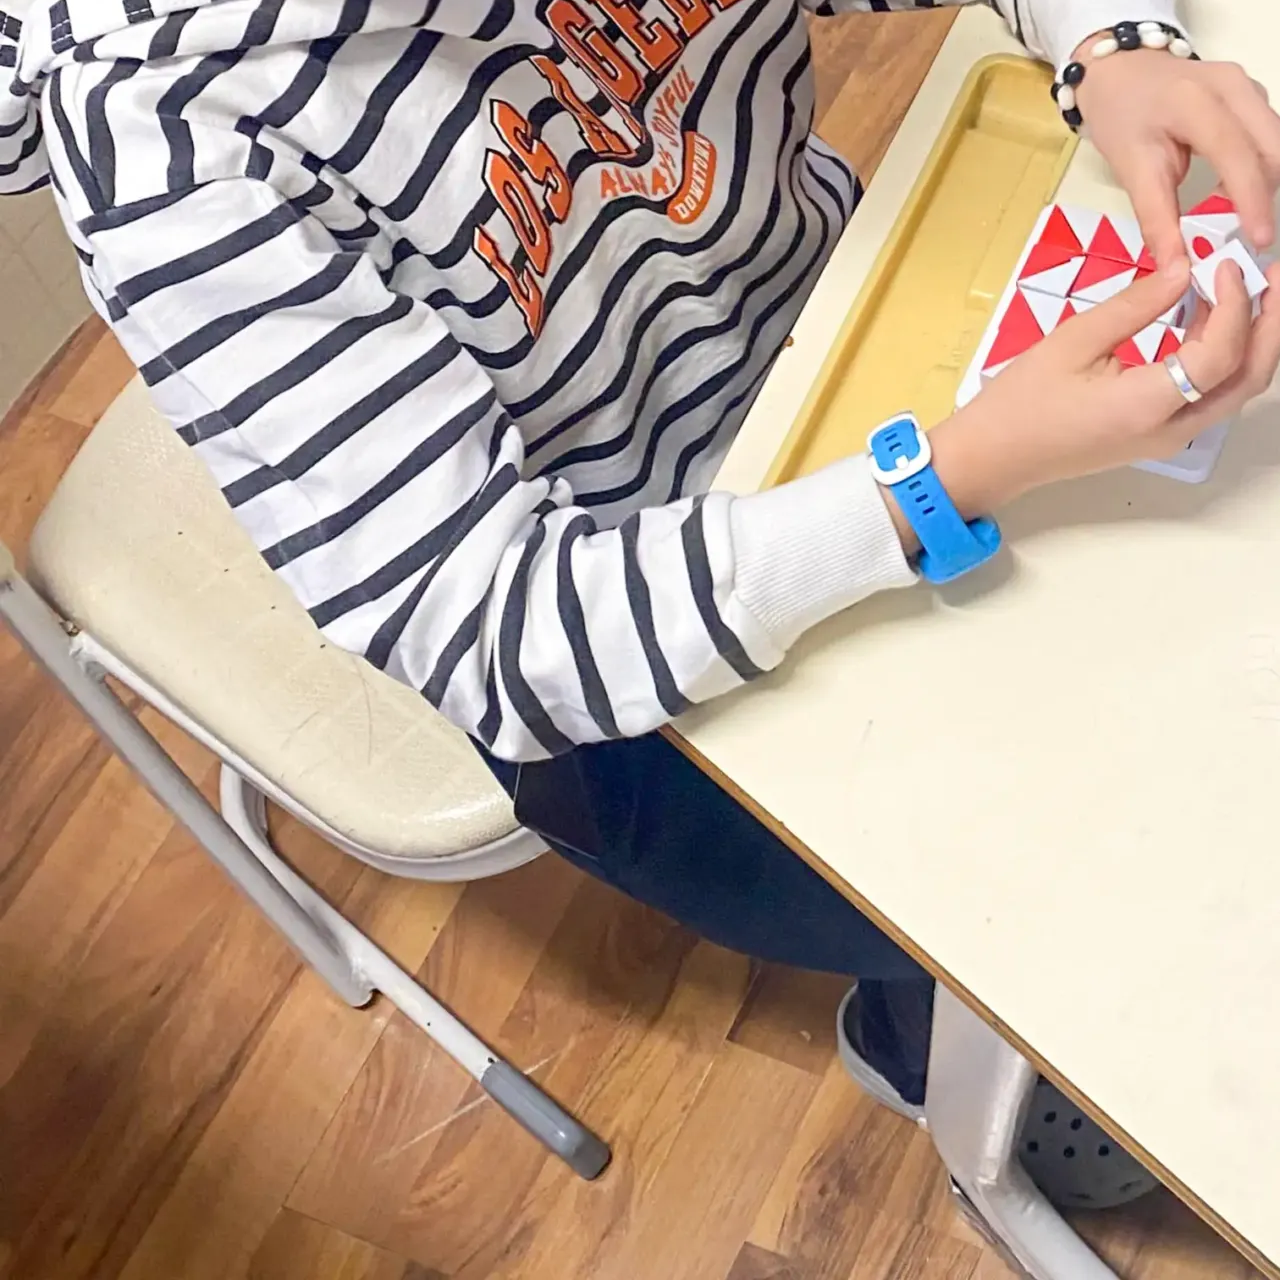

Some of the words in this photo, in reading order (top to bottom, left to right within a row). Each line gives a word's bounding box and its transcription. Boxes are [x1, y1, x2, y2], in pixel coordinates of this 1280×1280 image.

[600, 145, 682, 201] ALWAYS
[648, 64, 697, 149] JOYFUL
[674, 134, 715, 220] DOWNTOWN
[473, 99, 573, 338] LOS
